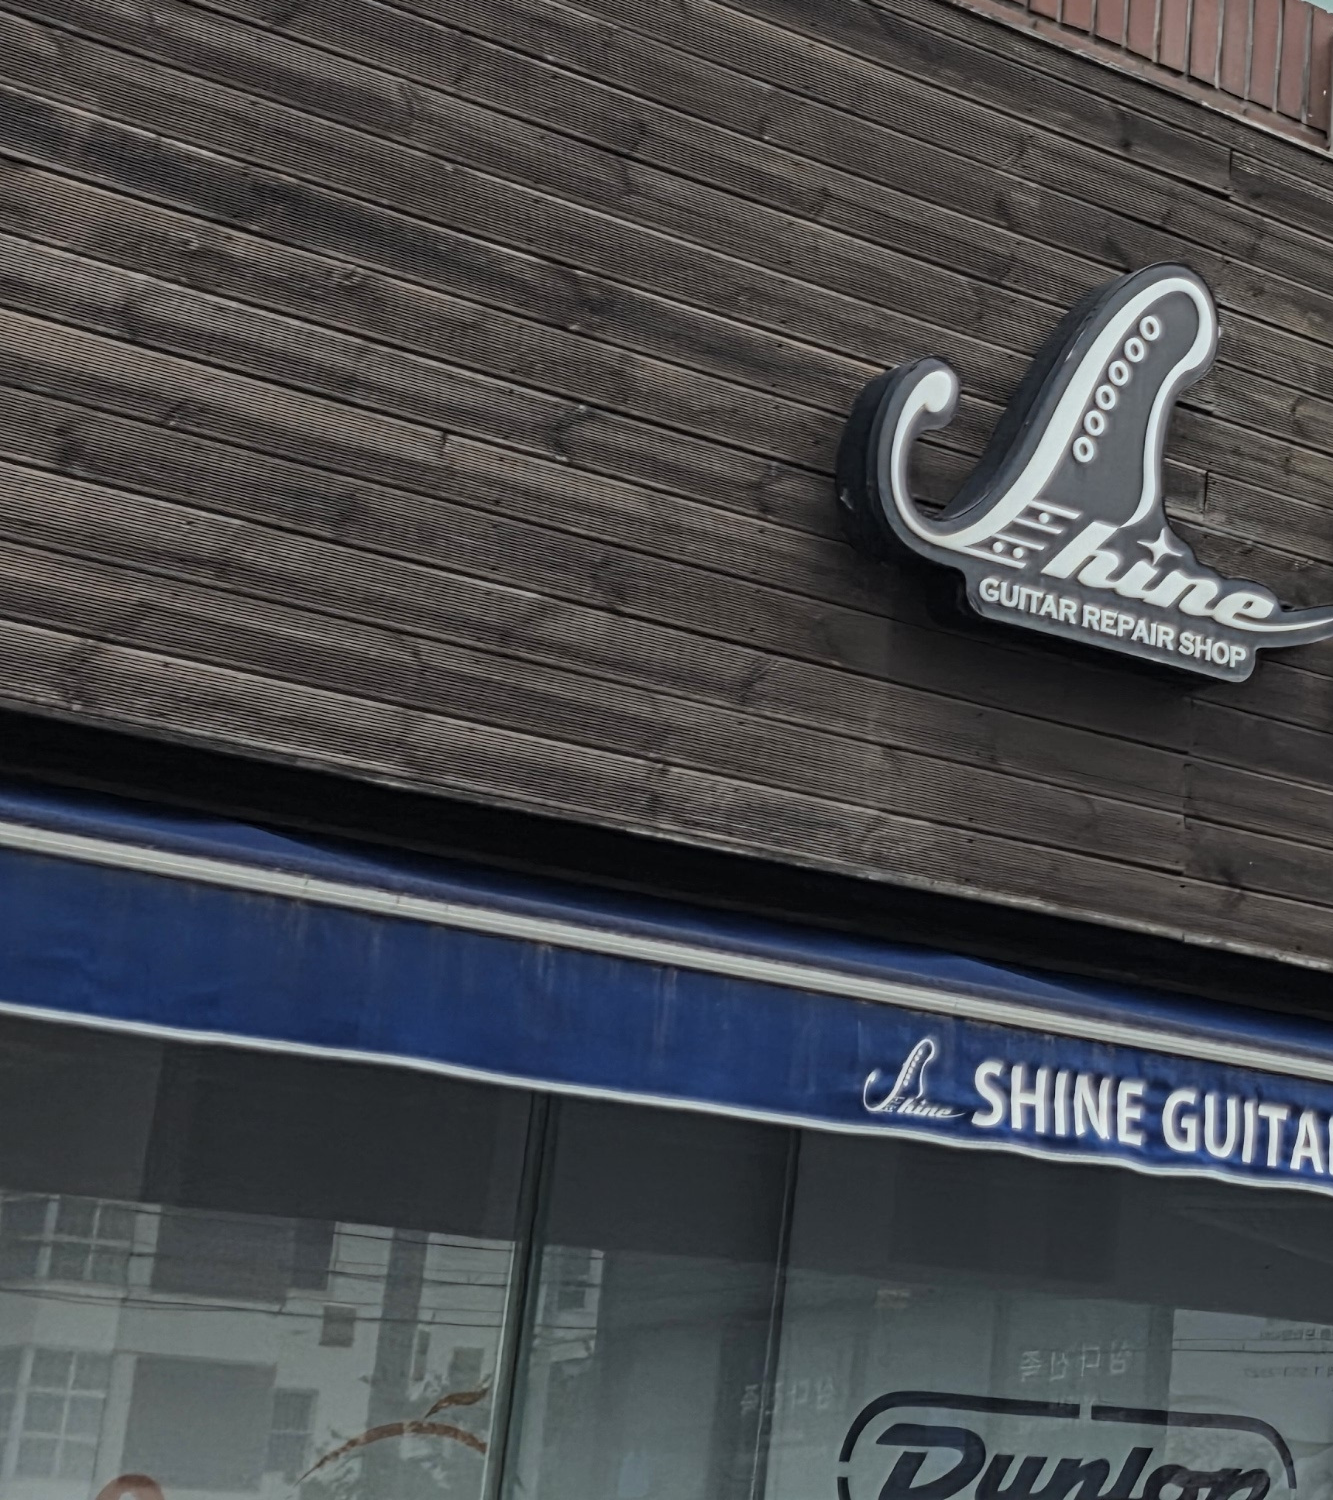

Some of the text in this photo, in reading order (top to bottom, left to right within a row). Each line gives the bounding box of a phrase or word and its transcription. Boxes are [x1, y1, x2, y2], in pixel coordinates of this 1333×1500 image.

[978, 577, 1247, 669] GUITAR REPAIR SHOP
[971, 1060, 1147, 1146] SHINE
